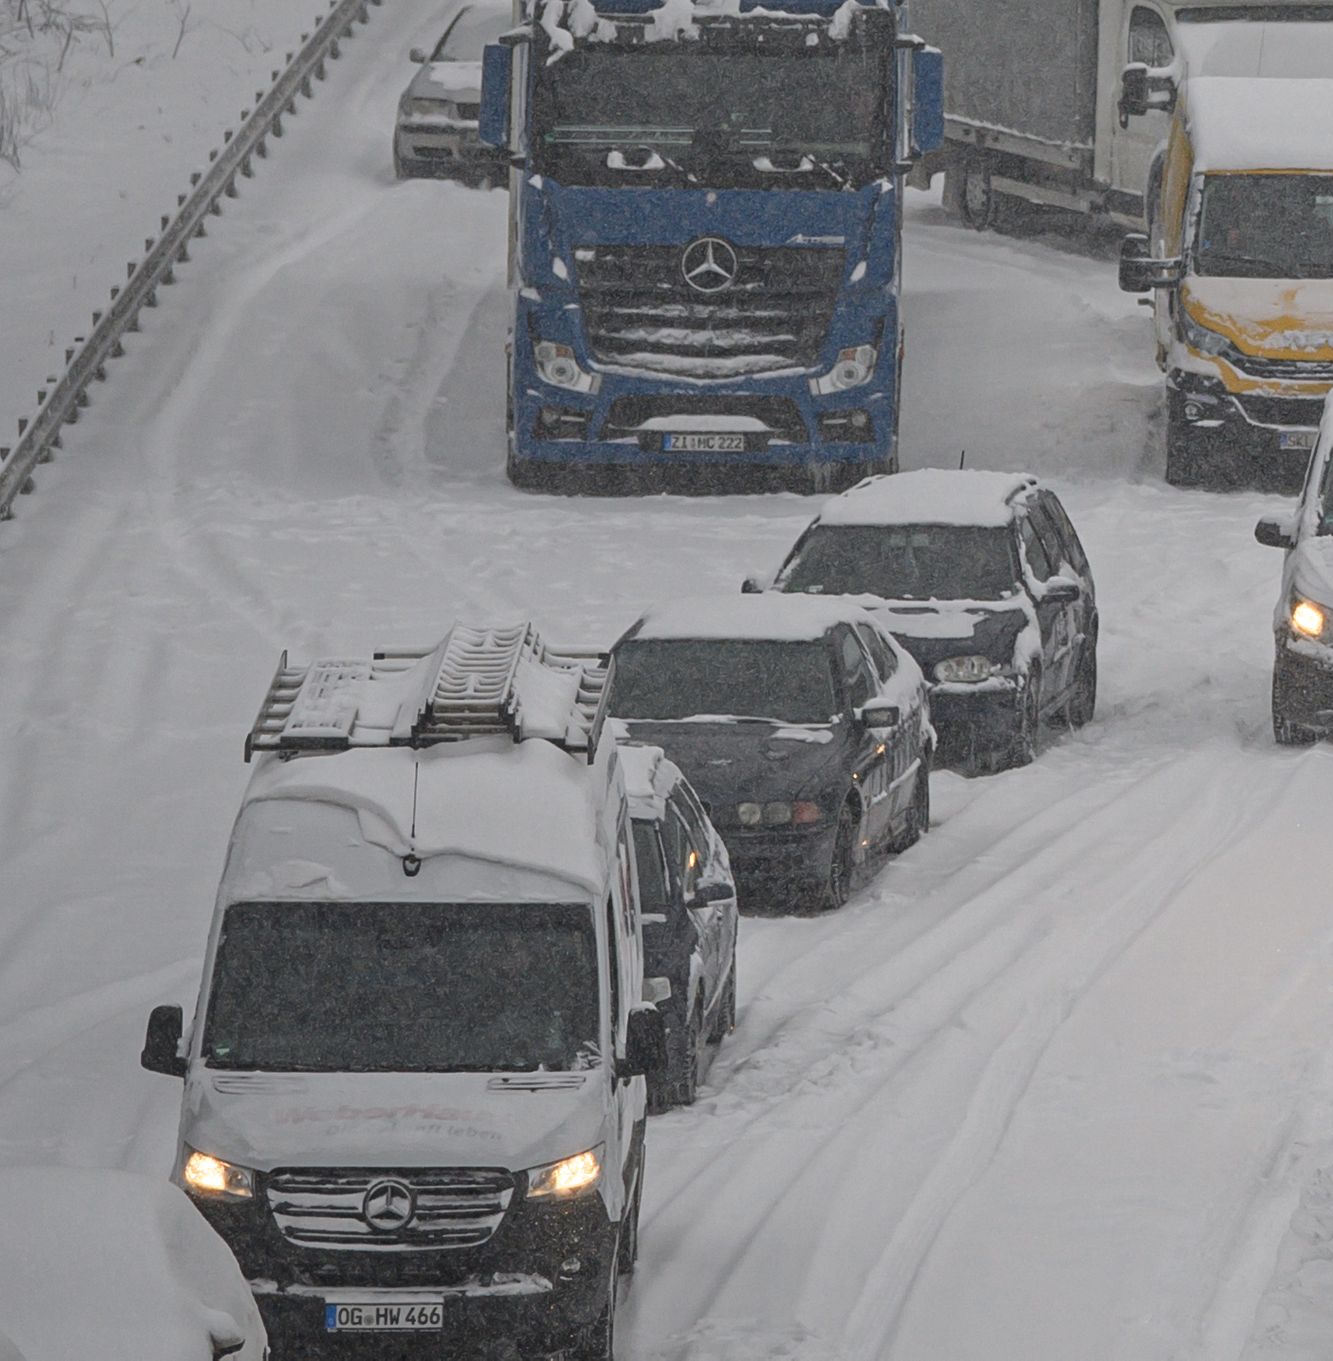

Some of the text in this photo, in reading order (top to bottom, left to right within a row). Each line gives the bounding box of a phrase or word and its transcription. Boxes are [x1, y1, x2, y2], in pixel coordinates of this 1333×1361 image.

[338, 1307, 441, 1327] OG HW 466
